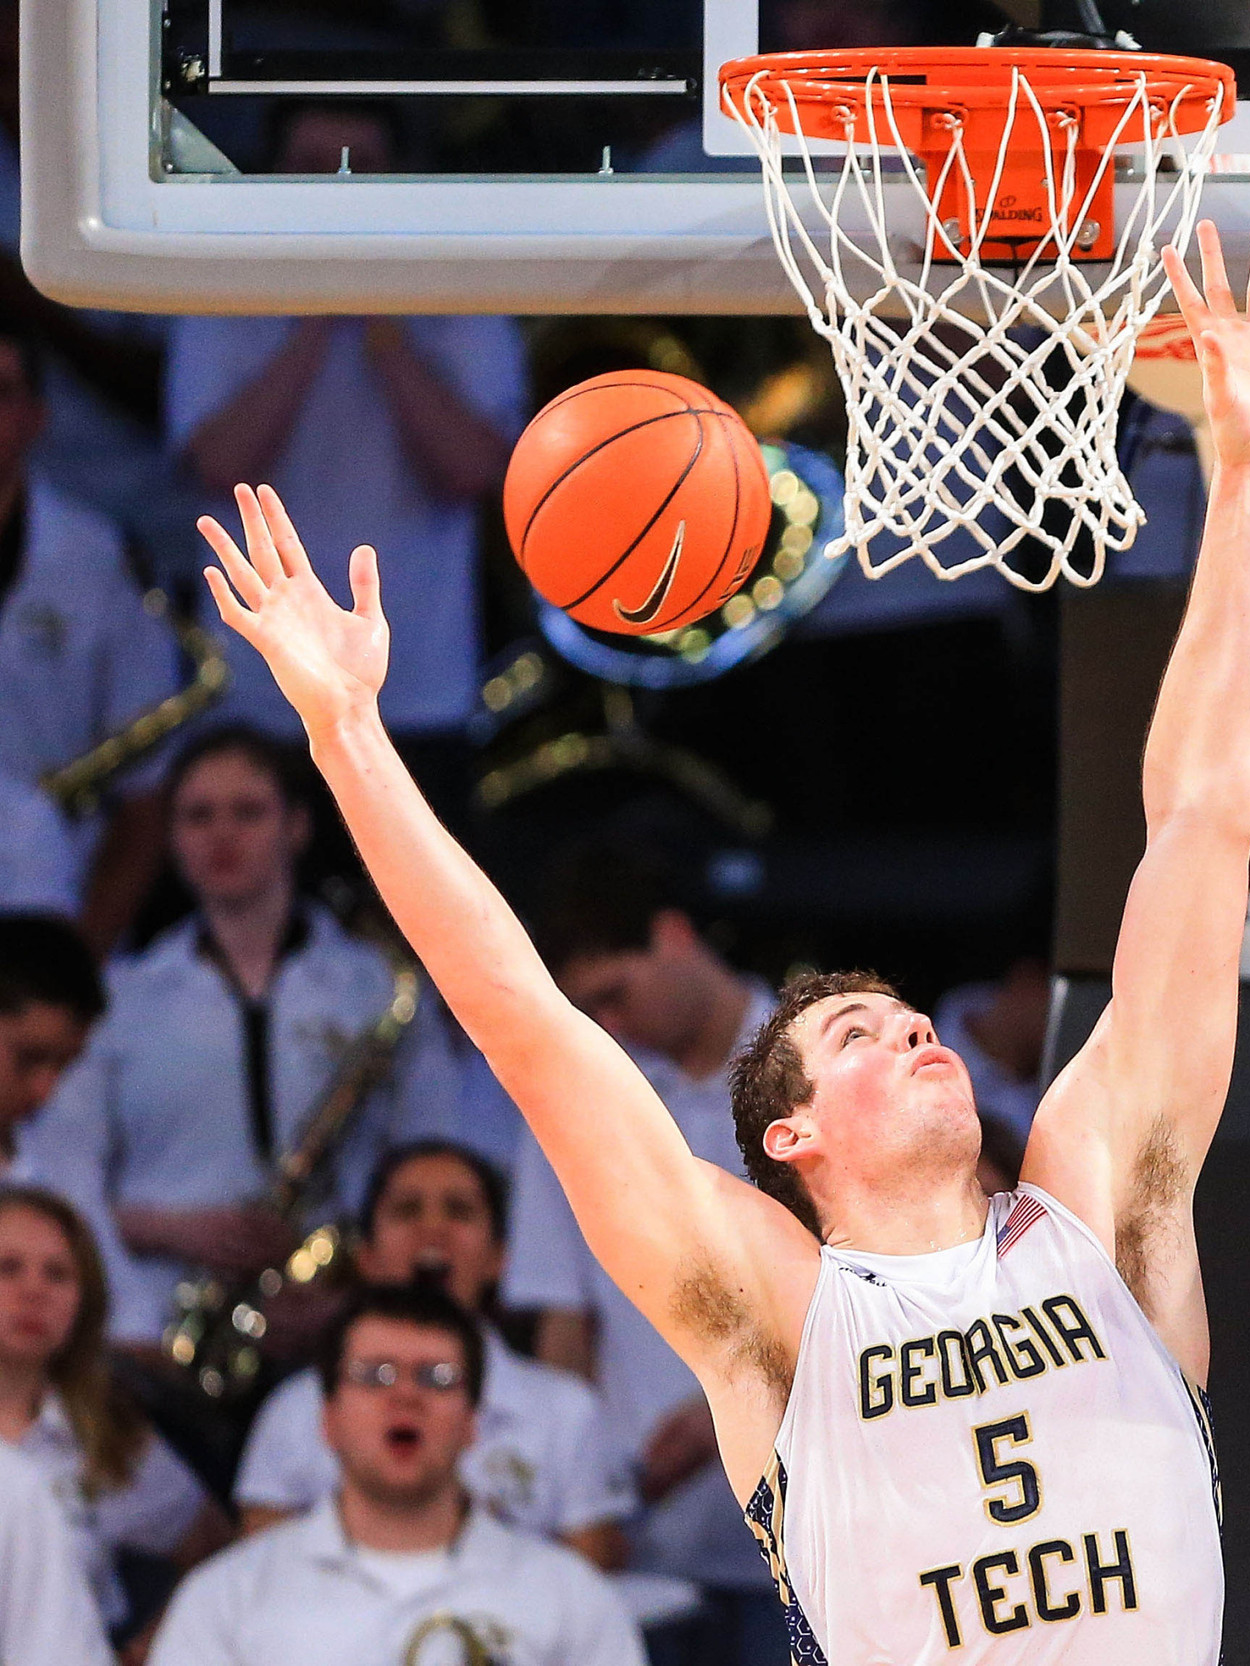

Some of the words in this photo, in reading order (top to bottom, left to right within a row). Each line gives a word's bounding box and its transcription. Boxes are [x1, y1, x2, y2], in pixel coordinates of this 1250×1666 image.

[974, 208, 1042, 222] SALDING
[860, 1294, 1108, 1421] GEORGIA
[972, 1410, 1042, 1527] 5
[918, 1528, 1139, 1649] TECH
